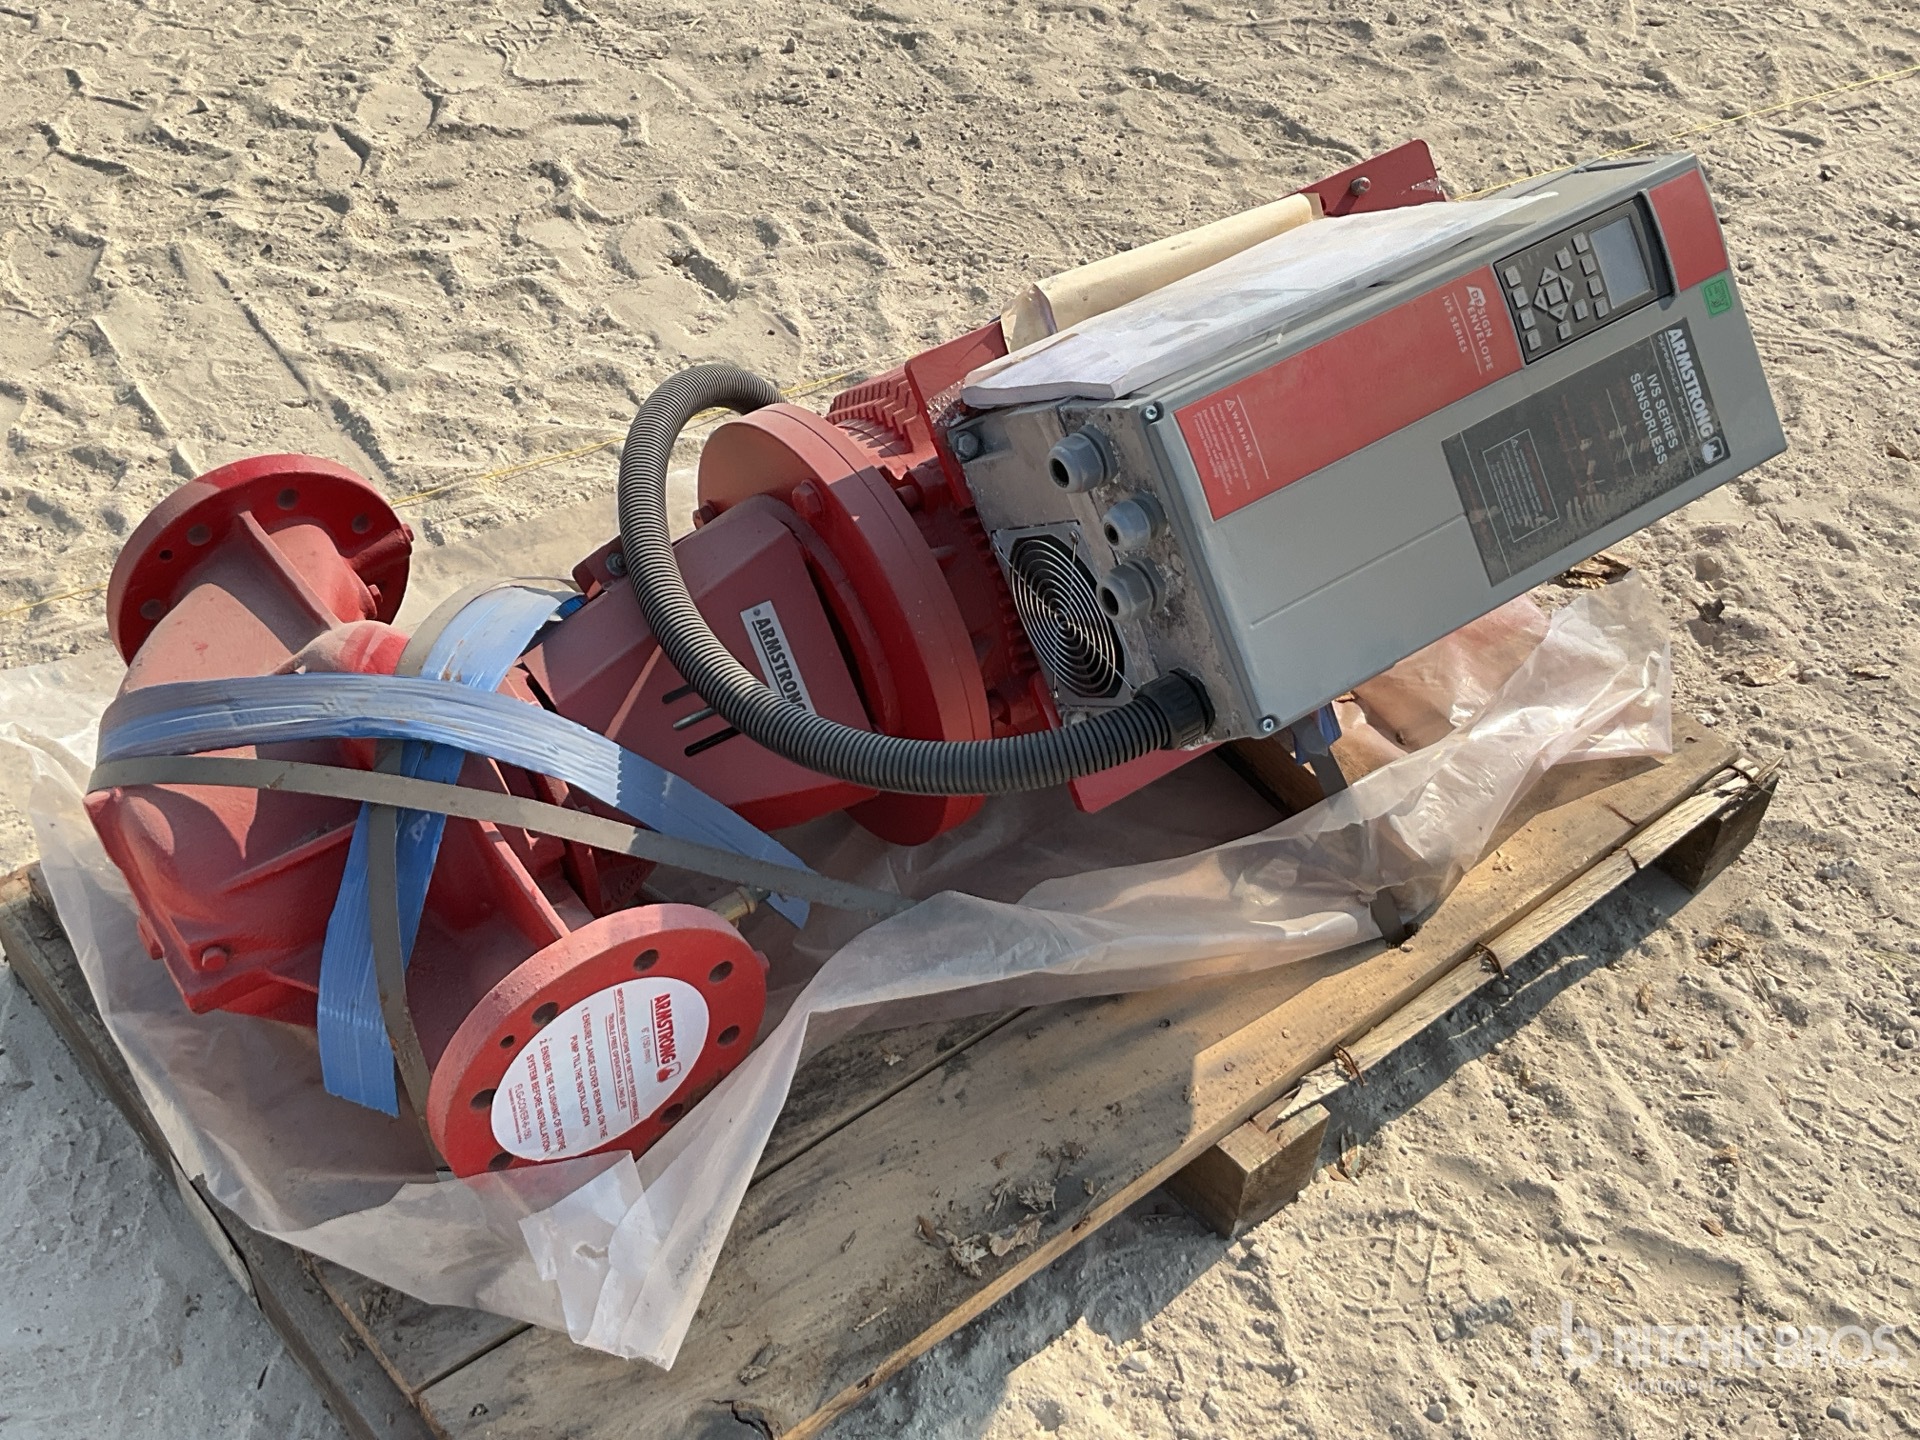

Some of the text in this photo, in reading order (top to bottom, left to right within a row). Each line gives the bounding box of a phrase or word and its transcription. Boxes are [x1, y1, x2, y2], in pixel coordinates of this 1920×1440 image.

[1442, 294, 1467, 353] IVS SERIES
[1470, 289, 1493, 338] DESIGN
[1466, 305, 1493, 371] ENVELOPE
[1666, 327, 1715, 439] ARMSTRONG
[1629, 371, 1668, 465] SENSORLESS
[1646, 372, 1679, 449] IVS SERIES
[1231, 410, 1253, 458] WARNING
[616, 987, 625, 1015] IMPORTANT
[582, 1013, 592, 1040] ENSURE
[619, 1015, 629, 1053] INSTRUCTIONS
[654, 993, 676, 1064] ARMSTRONG
[540, 1045, 552, 1073] ENSURE
[585, 1039, 595, 1066] FLANGE
[607, 1012, 615, 1035] TROUBLE
[612, 1049, 622, 1079] OPERATION
[617, 1083, 625, 1098] LONG
[545, 1071, 554, 1086] THE
[569, 1034, 591, 1127] PUMP TILL THE INSTALLATION
[588, 1065, 599, 1088] COVER
[526, 1053, 550, 1152] SYSTEM BEFORE INSTALLATION
[547, 1085, 559, 1118] FLUSHING
[592, 1088, 603, 1114] REMAIN
[597, 1114, 605, 1125] ON
[629, 1084, 639, 1122] PERFORMANCE
[553, 1118, 561, 1127] OF
[555, 1128, 566, 1151] ENTIRE
[599, 1124, 607, 1139] THE
